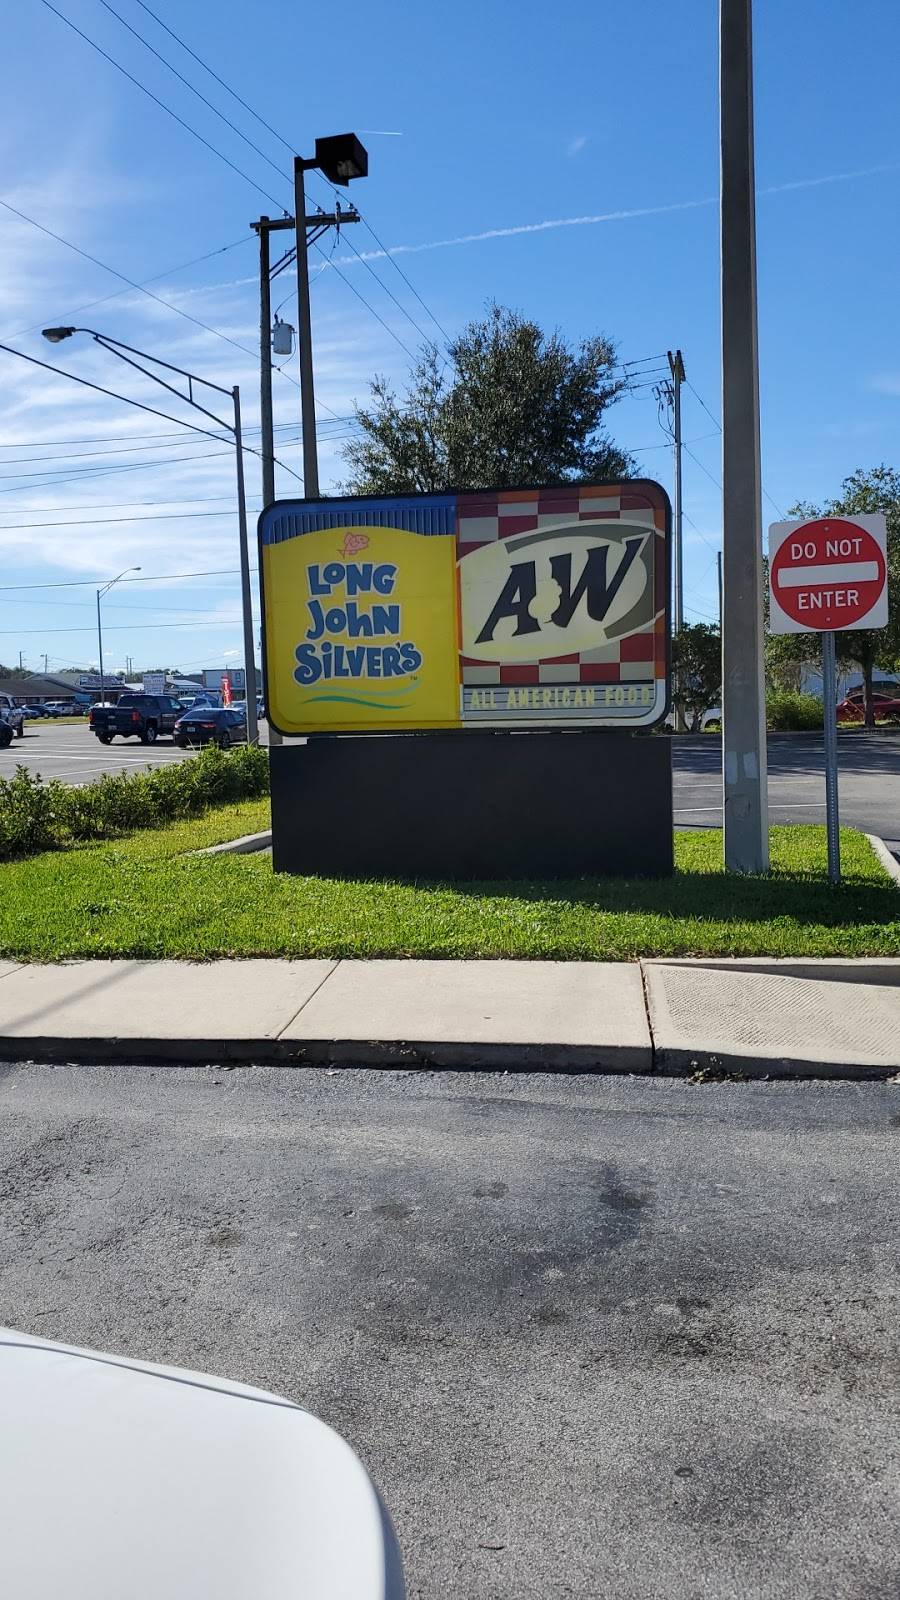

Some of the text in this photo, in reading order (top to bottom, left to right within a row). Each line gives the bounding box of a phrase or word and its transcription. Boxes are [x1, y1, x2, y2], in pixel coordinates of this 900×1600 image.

[791, 538, 863, 560] DO NOT
[306, 562, 398, 596] LONG
[798, 589, 860, 610] ENTER
[470, 686, 650, 709] ALL AMERICAN FOOD
